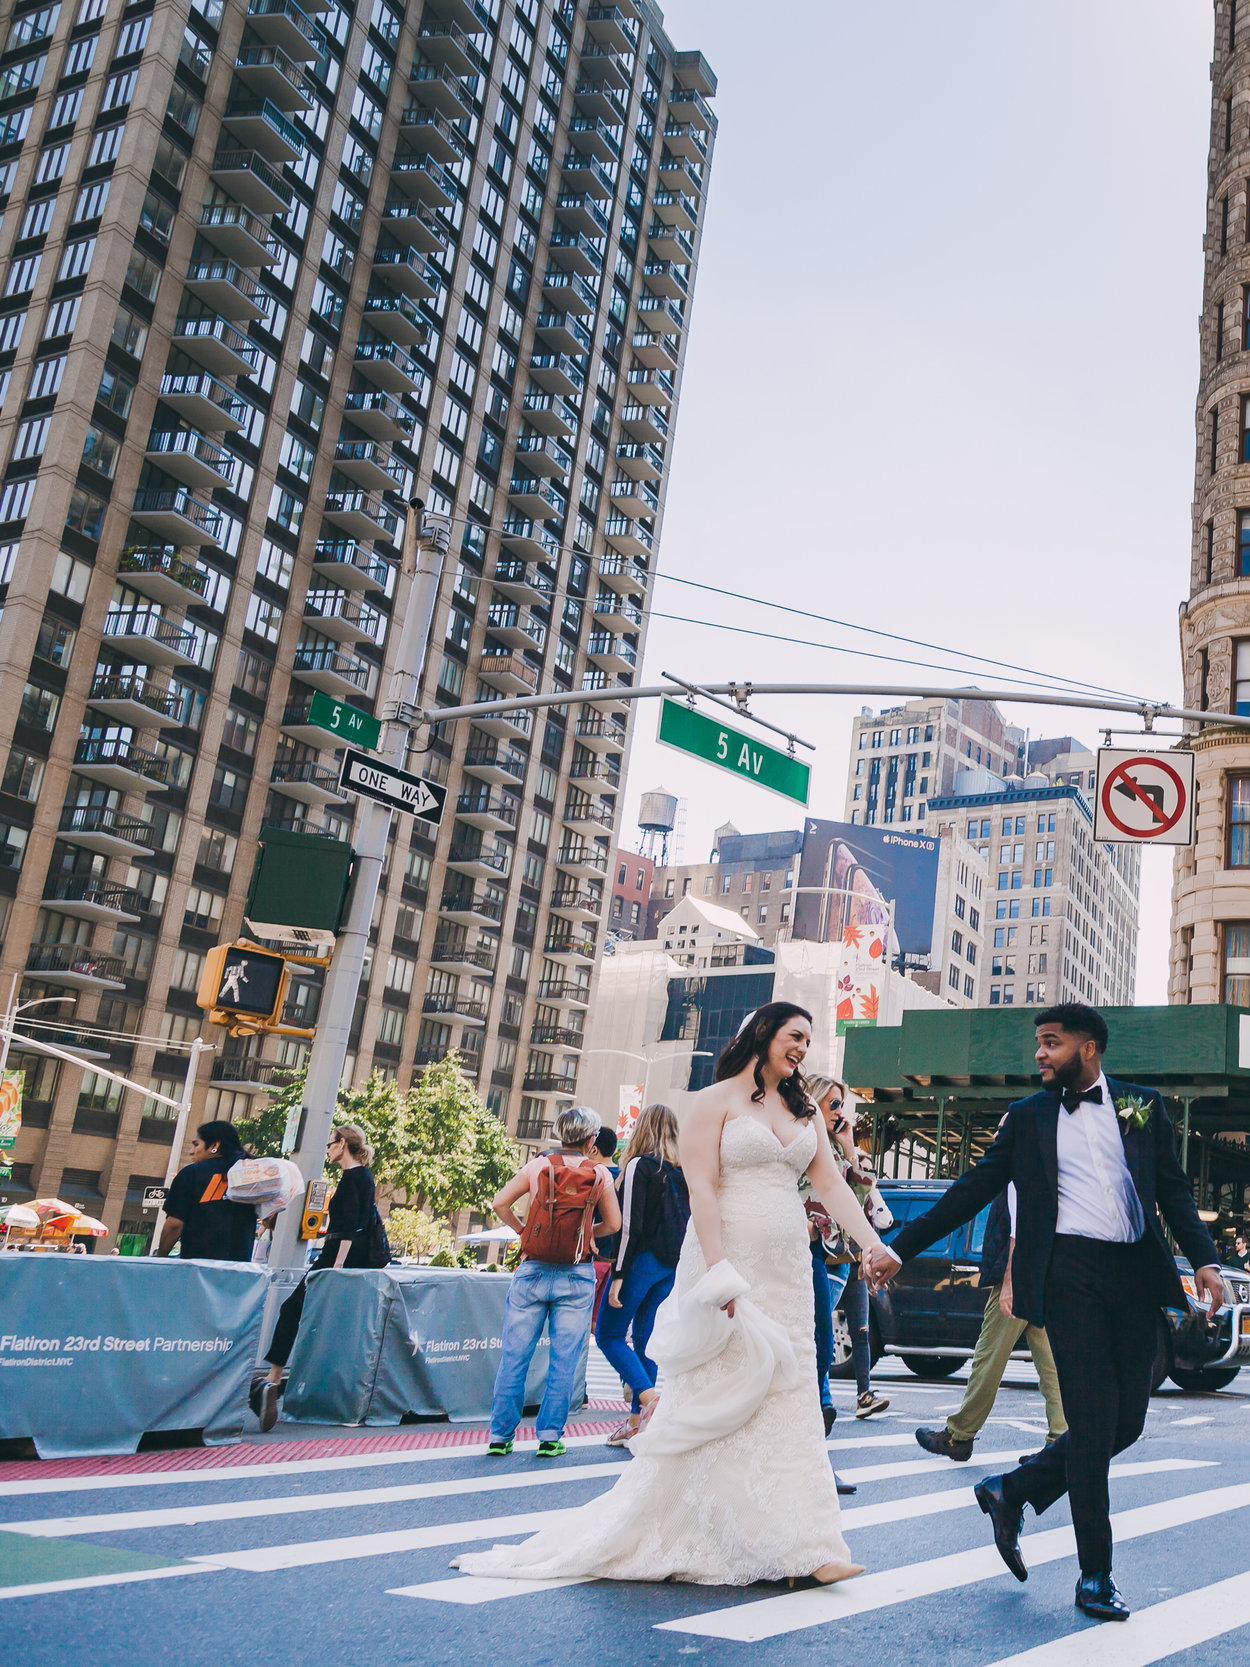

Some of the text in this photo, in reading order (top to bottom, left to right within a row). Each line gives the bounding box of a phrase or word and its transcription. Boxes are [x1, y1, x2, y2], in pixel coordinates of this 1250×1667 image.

[330, 706, 342, 729] 5
[717, 732, 728, 760] 5
[358, 767, 389, 791] ONE
[400, 784, 431, 807] WAY
[890, 835, 919, 848] iPhone
[0, 1335, 234, 1355] Flatiron 23rd Street Partnership
[425, 1340, 460, 1353] Flatiron
[462, 1338, 488, 1350] 23rd
